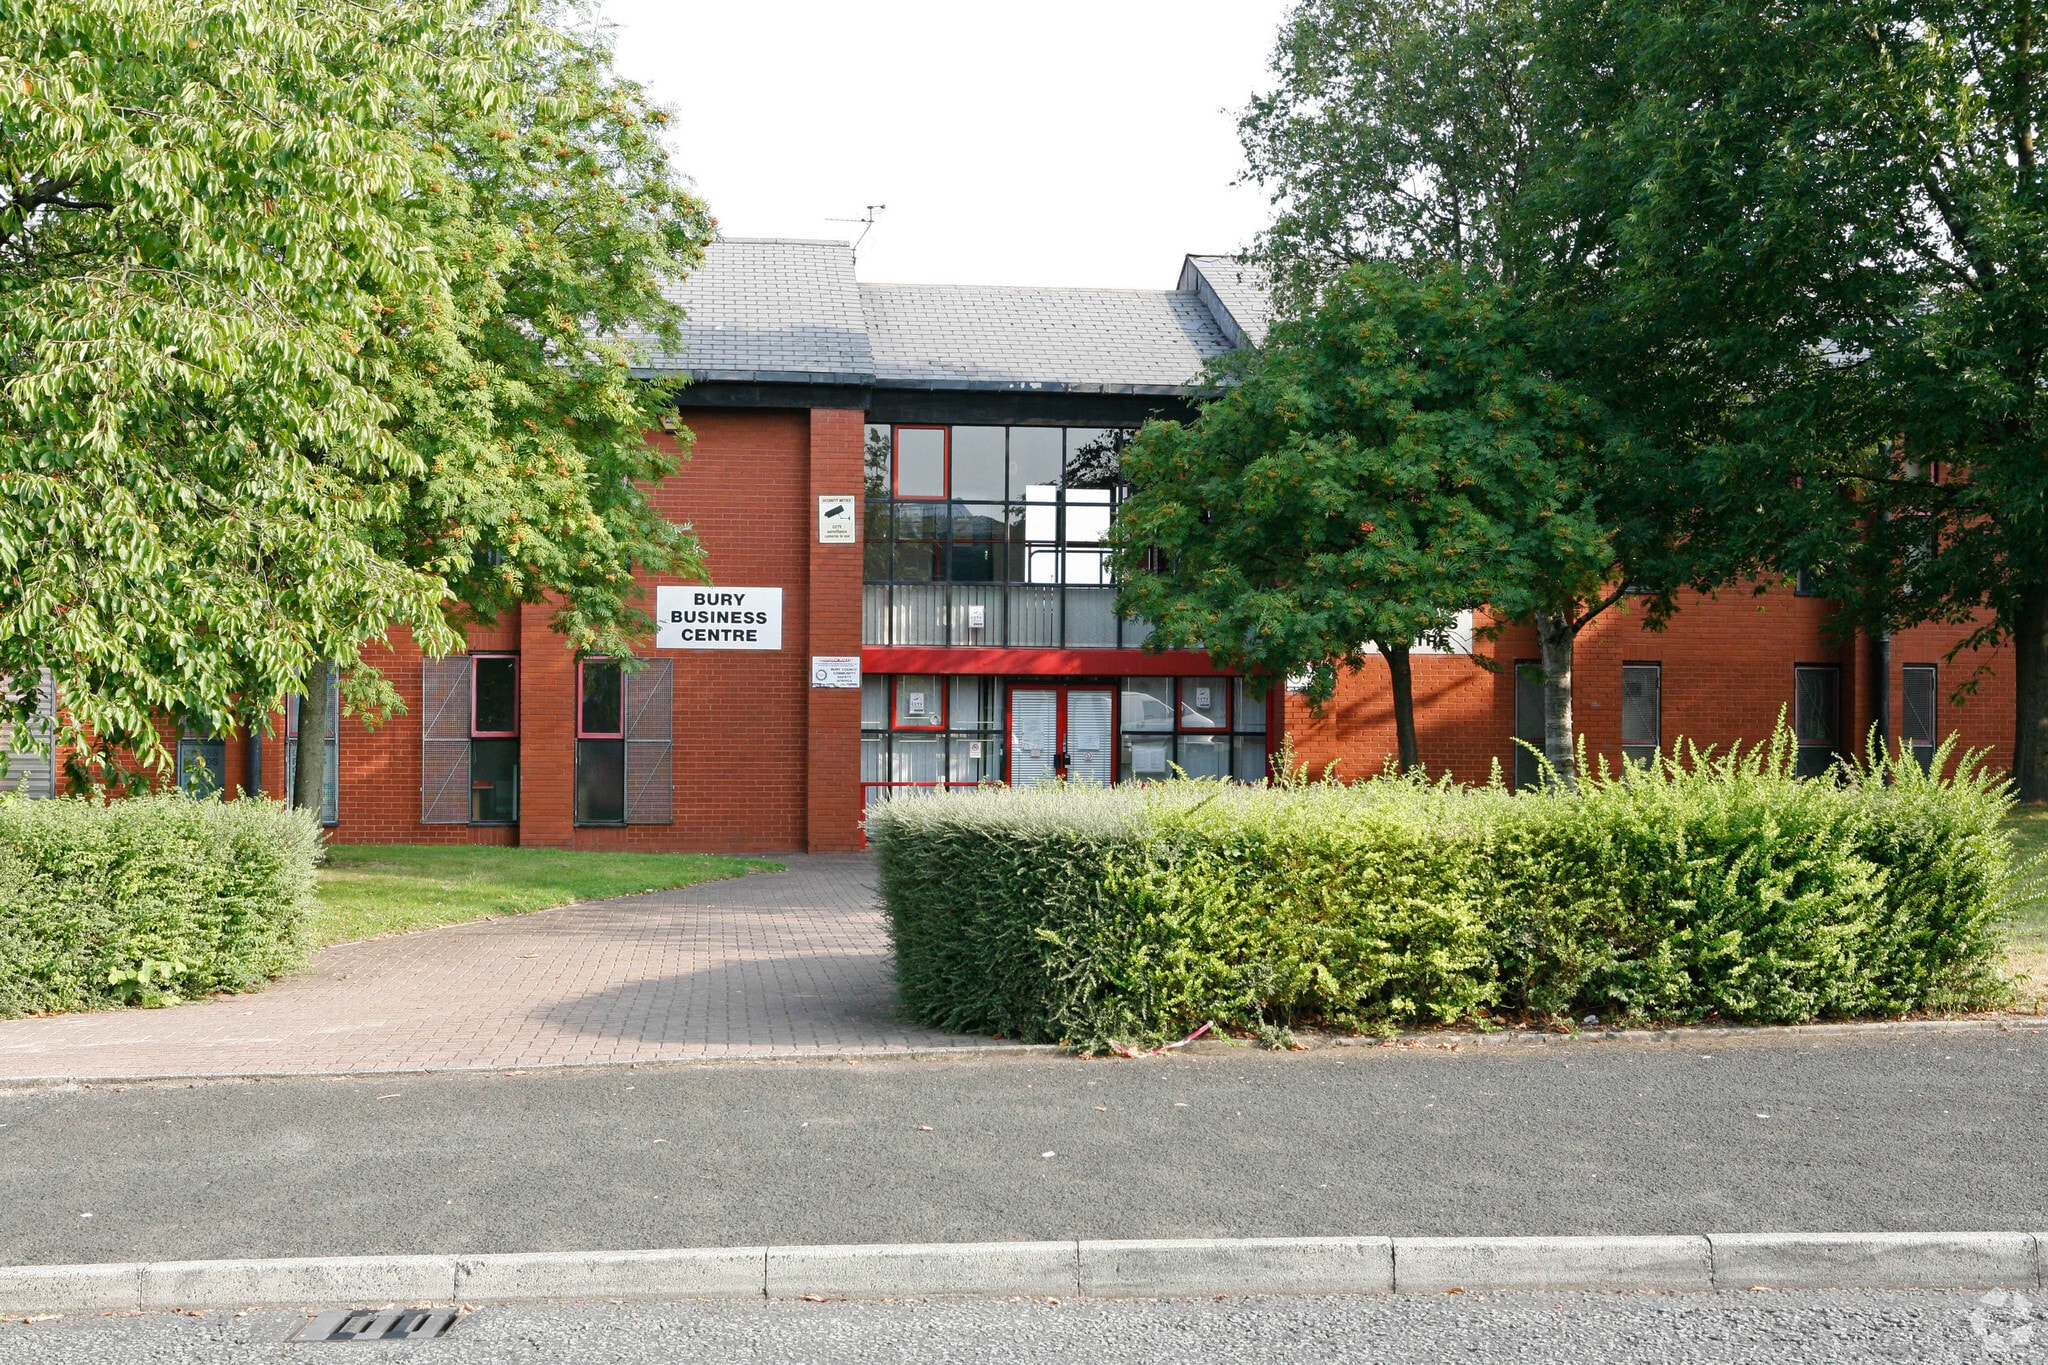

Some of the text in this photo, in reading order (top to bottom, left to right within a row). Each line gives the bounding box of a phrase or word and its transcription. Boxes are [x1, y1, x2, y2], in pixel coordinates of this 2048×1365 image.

[694, 593, 745, 606] BURY
[671, 610, 767, 624] BUSINESS
[681, 628, 757, 642] CENTRE
